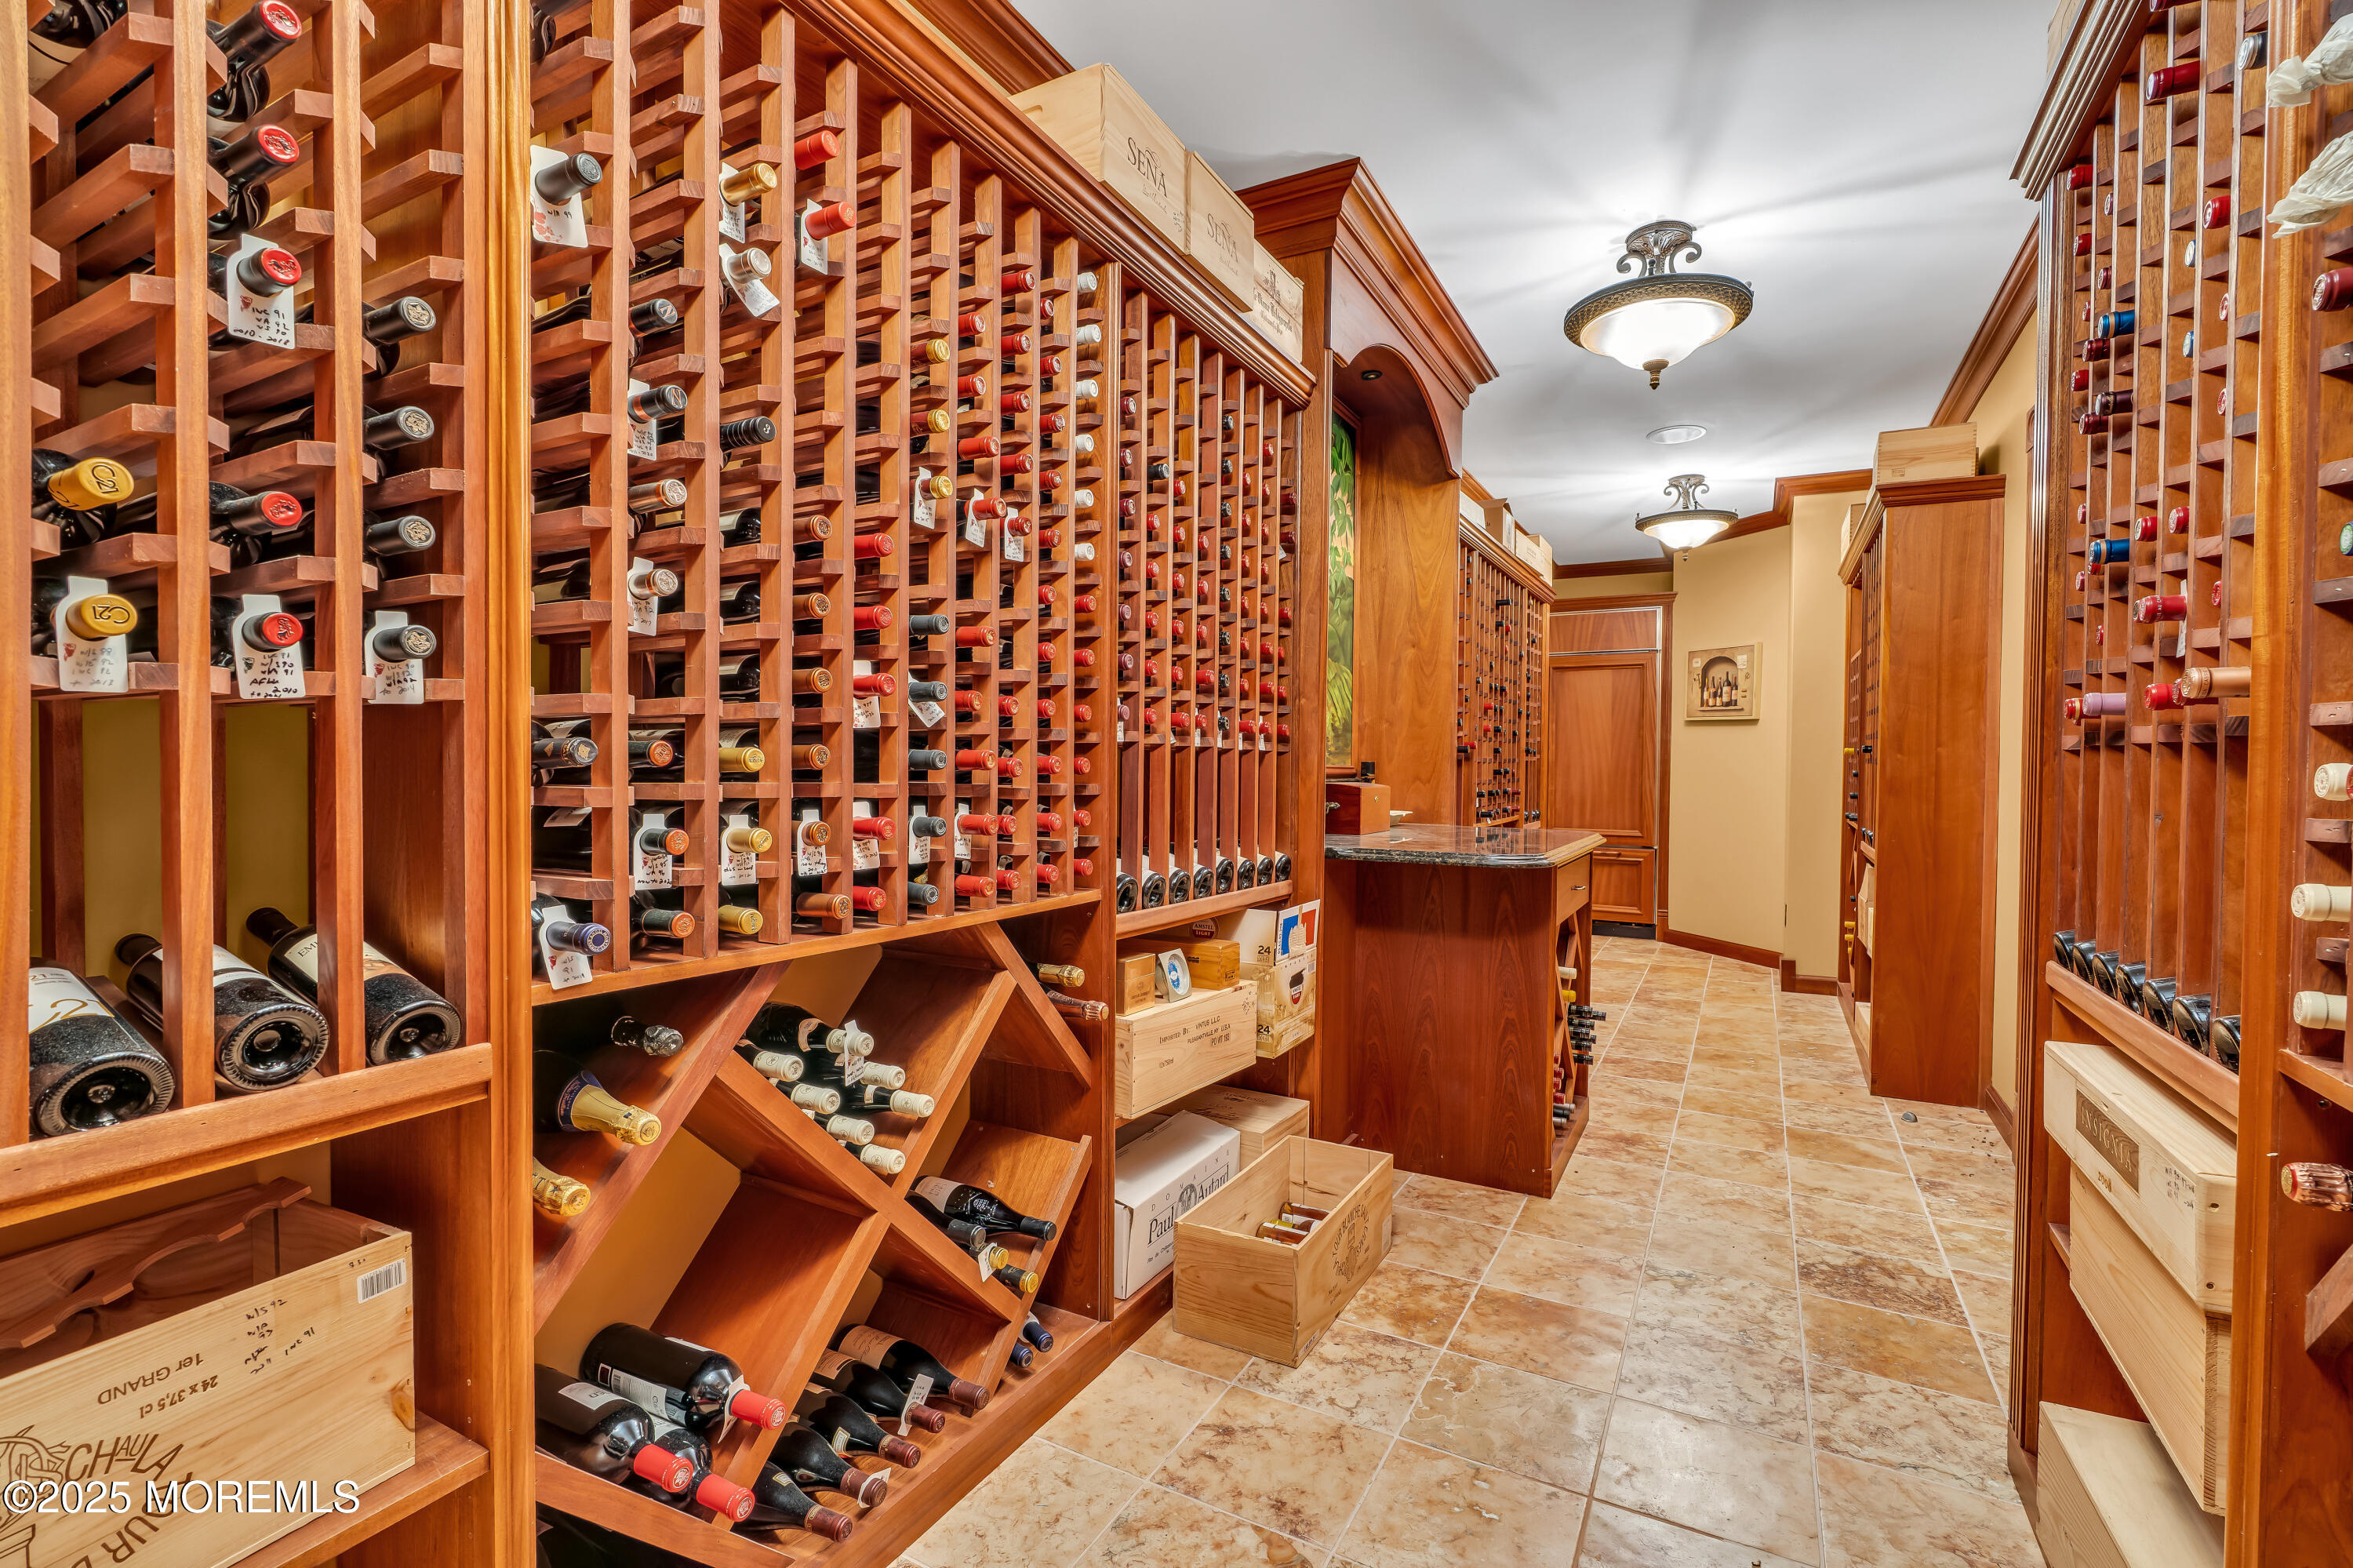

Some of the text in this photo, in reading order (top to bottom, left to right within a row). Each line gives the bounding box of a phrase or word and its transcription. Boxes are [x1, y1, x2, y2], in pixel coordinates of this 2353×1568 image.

[1257, 945, 1271, 955] 24
[1257, 1024, 1271, 1035] 24
[2082, 1106, 2132, 1173] INSIGNIA
[1198, 1164, 1229, 1202] Autard
[1147, 1205, 1174, 1245] Paul
[97, 1353, 204, 1405] 1er GRAND
[202, 1374, 218, 1392] 24
